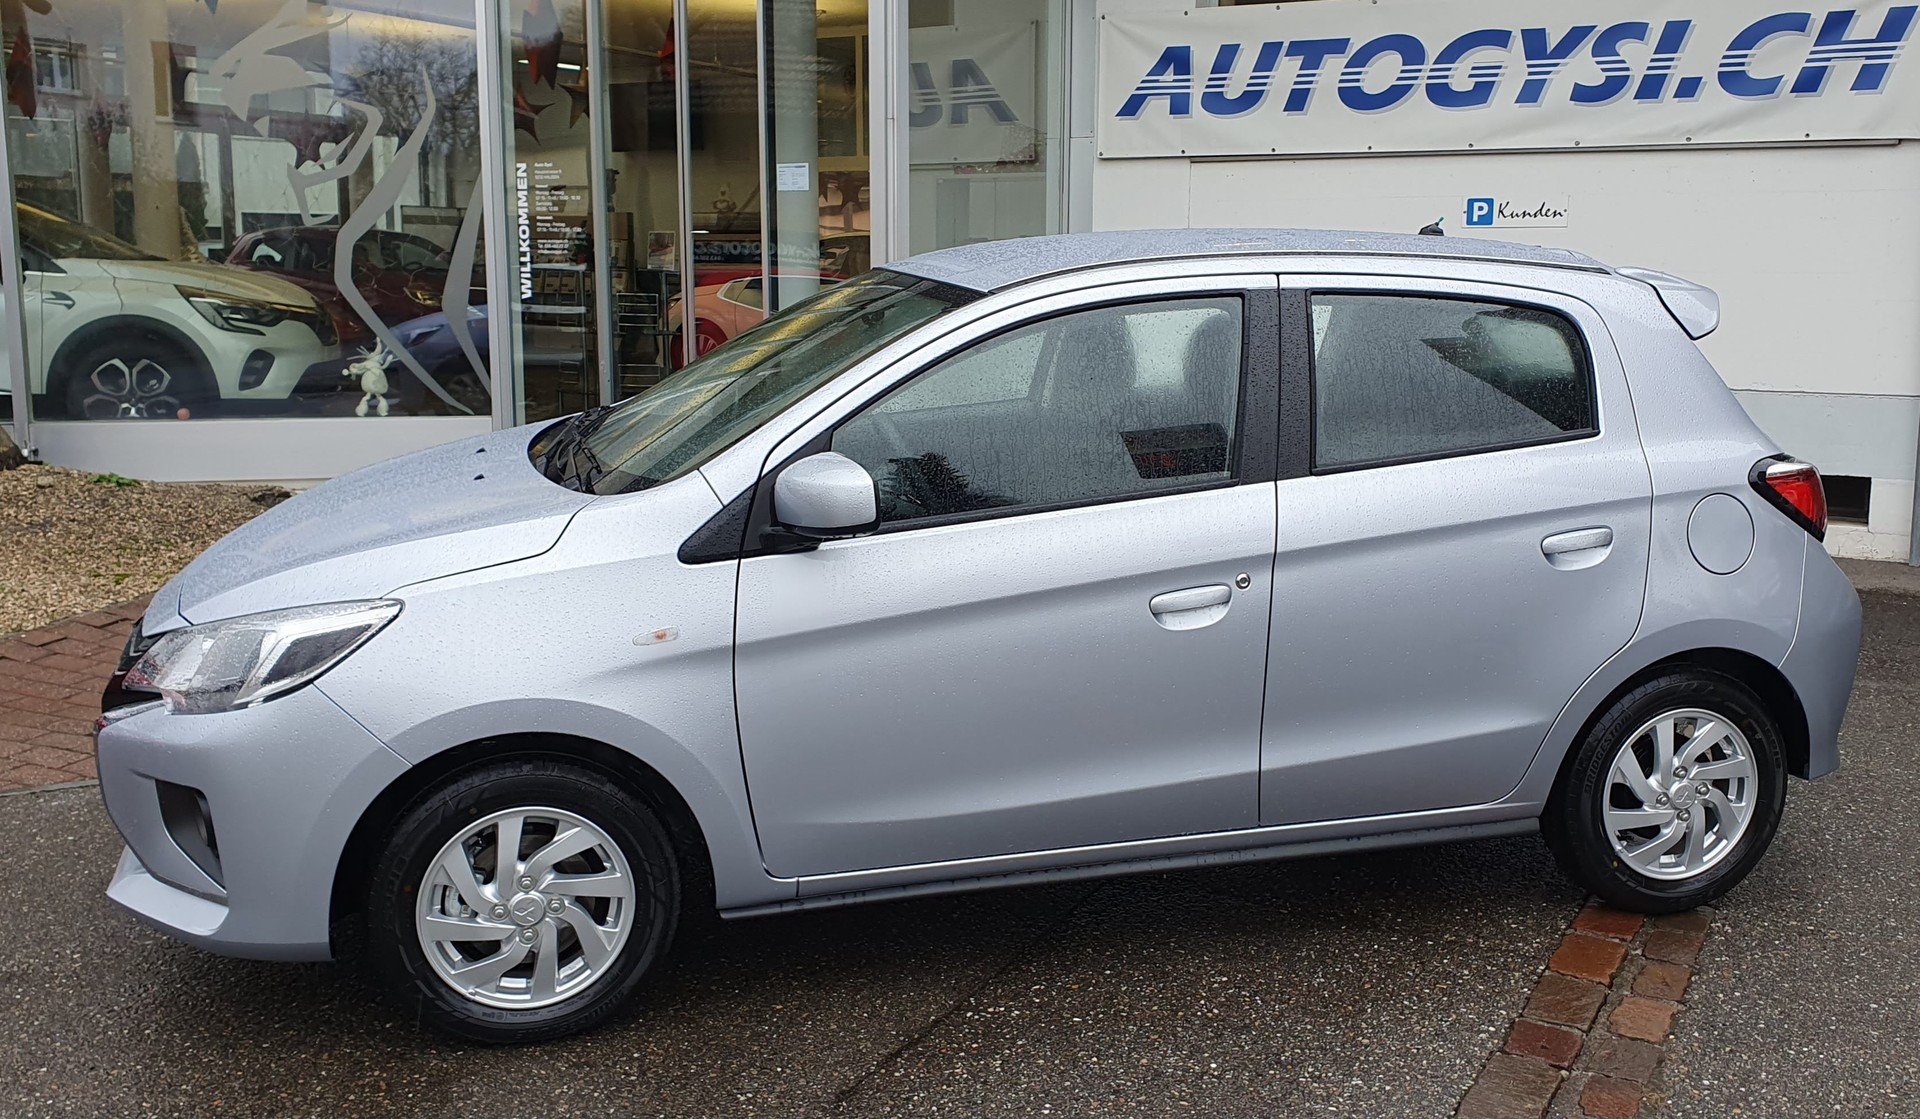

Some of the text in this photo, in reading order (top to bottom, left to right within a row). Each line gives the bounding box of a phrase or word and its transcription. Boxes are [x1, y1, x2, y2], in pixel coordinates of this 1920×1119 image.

[1115, 5, 1919, 122] AUTOGYSI.CH
[516, 162, 532, 299] WILLKOMMEN
[1472, 201, 1563, 222] P Kunden
